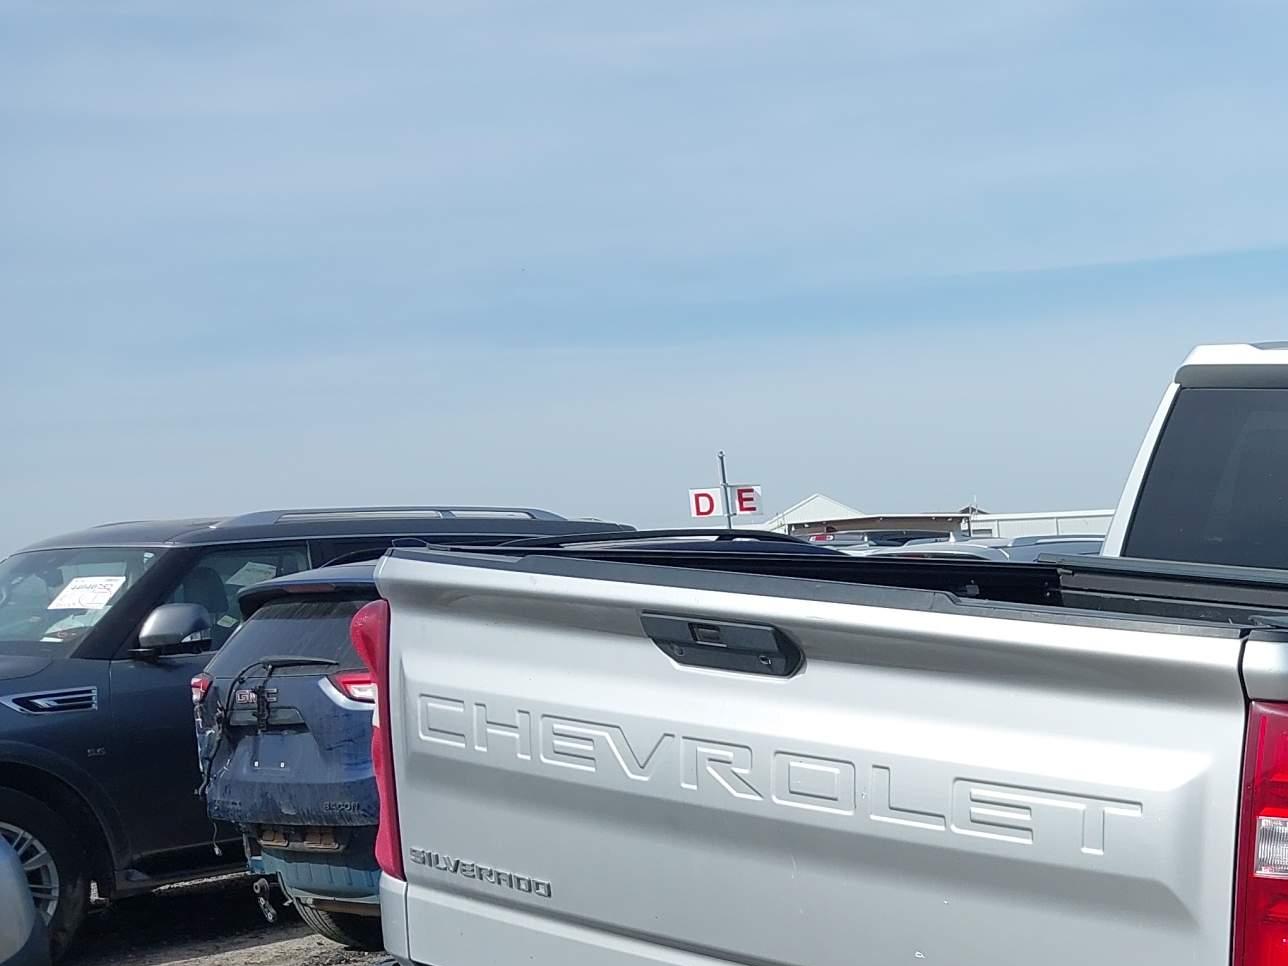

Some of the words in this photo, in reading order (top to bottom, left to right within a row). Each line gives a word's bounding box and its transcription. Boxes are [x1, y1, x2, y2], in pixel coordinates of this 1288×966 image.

[694, 493, 714, 516] D
[737, 488, 757, 512] E
[417, 692, 1144, 857] CHEVROLET
[409, 847, 553, 898] SILVERADO
